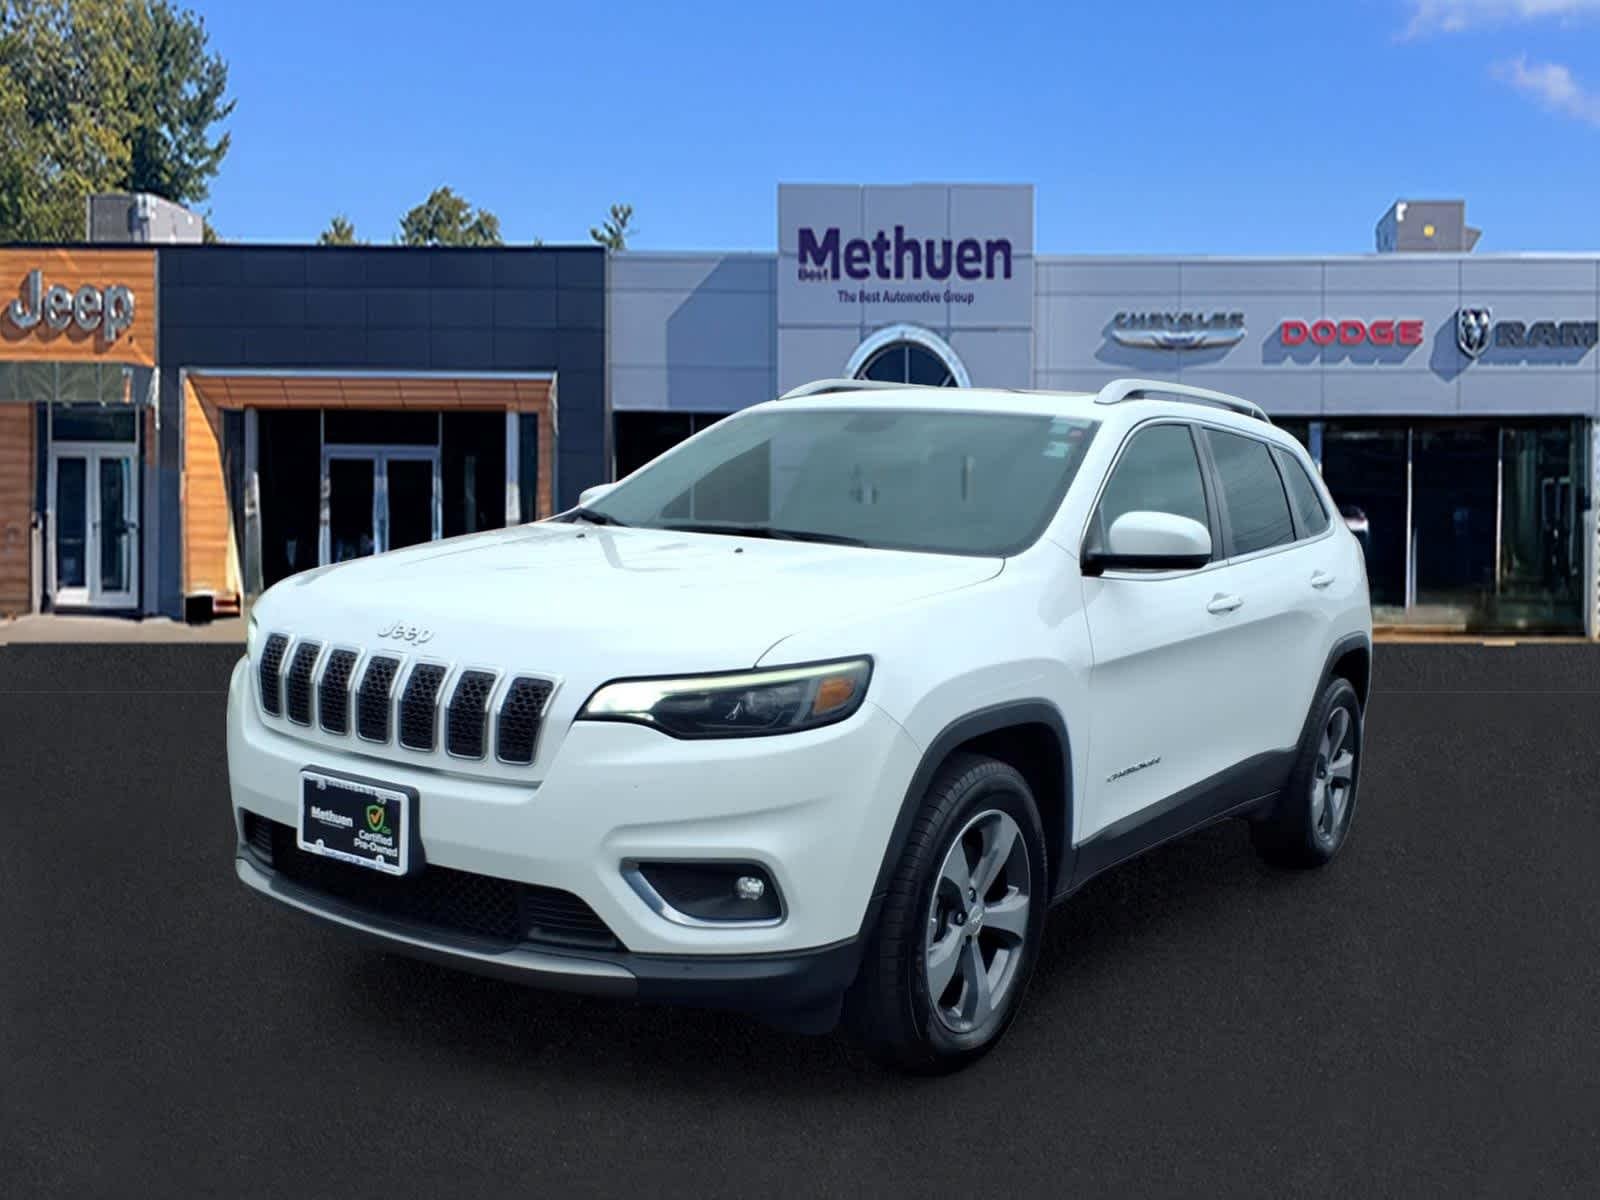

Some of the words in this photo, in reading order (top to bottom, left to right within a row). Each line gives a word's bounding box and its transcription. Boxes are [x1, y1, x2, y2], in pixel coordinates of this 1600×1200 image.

[798, 226, 1012, 280] Methuen
[8, 269, 134, 342] Jeep
[838, 289, 857, 303] The
[858, 289, 880, 303] Best
[882, 289, 941, 303] Automotive
[943, 288, 975, 306] Group
[1113, 312, 1245, 330] CHRYSLER
[1281, 320, 1424, 346] DODGE
[1494, 321, 1599, 348] RAM
[377, 619, 435, 646] Jeep
[310, 806, 354, 827] Methuen
[353, 837, 398, 857] Pre-Owned
[358, 829, 393, 847] Certified
